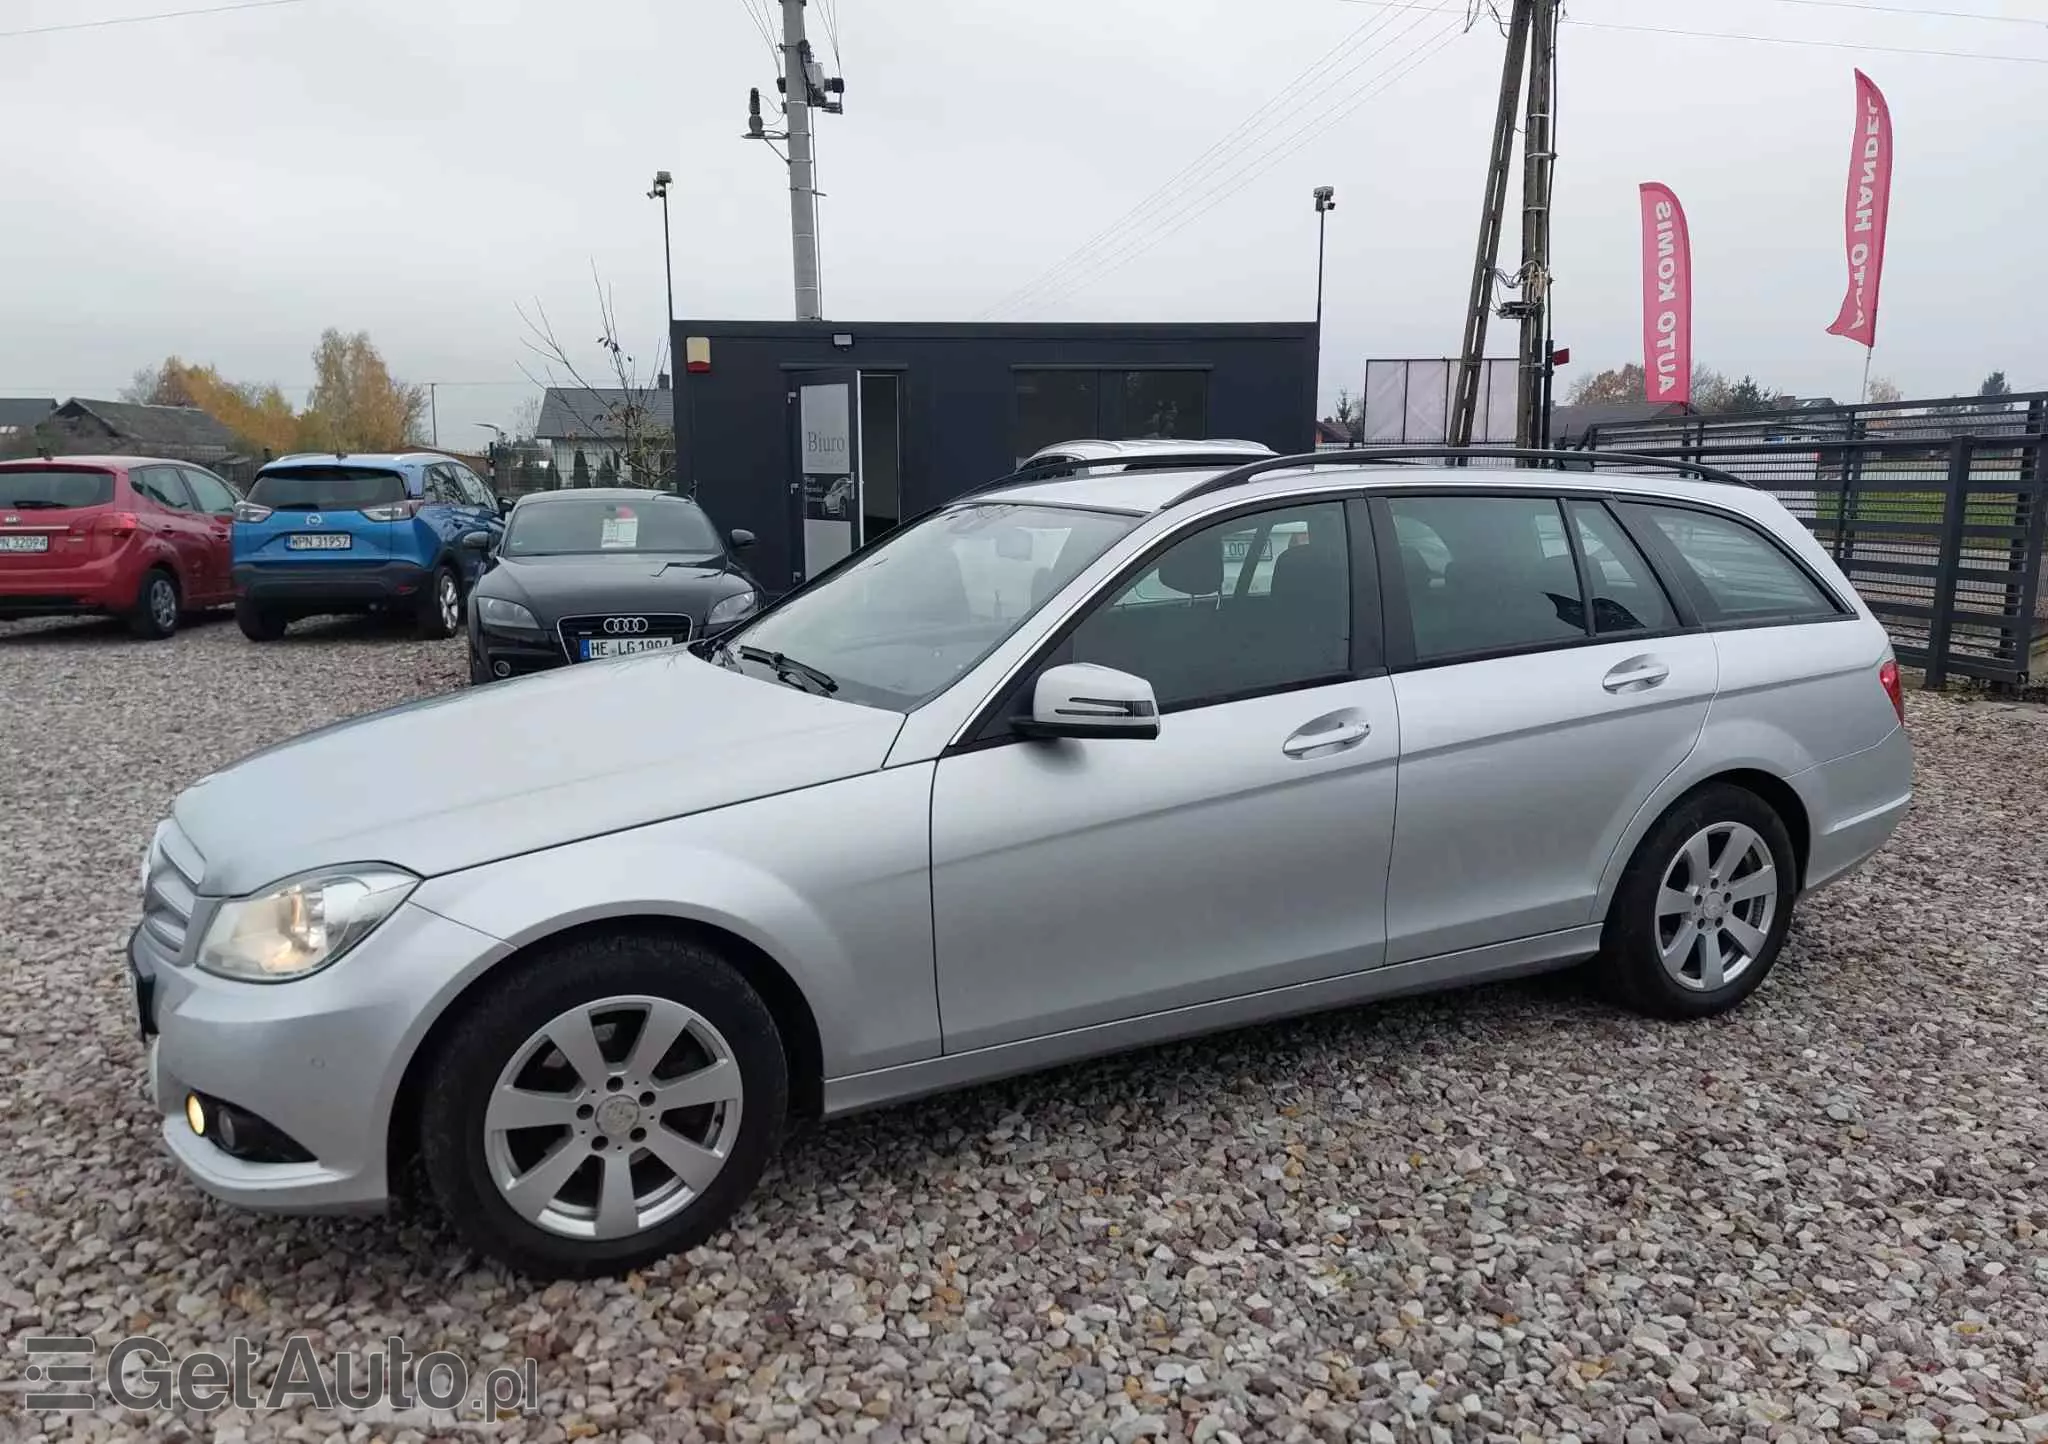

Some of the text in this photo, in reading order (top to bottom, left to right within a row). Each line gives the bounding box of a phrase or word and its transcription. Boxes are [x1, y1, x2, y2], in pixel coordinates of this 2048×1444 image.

[808, 430, 846, 453] Biuro
[591, 641, 609, 656] HE
[618, 640, 636, 656] LG
